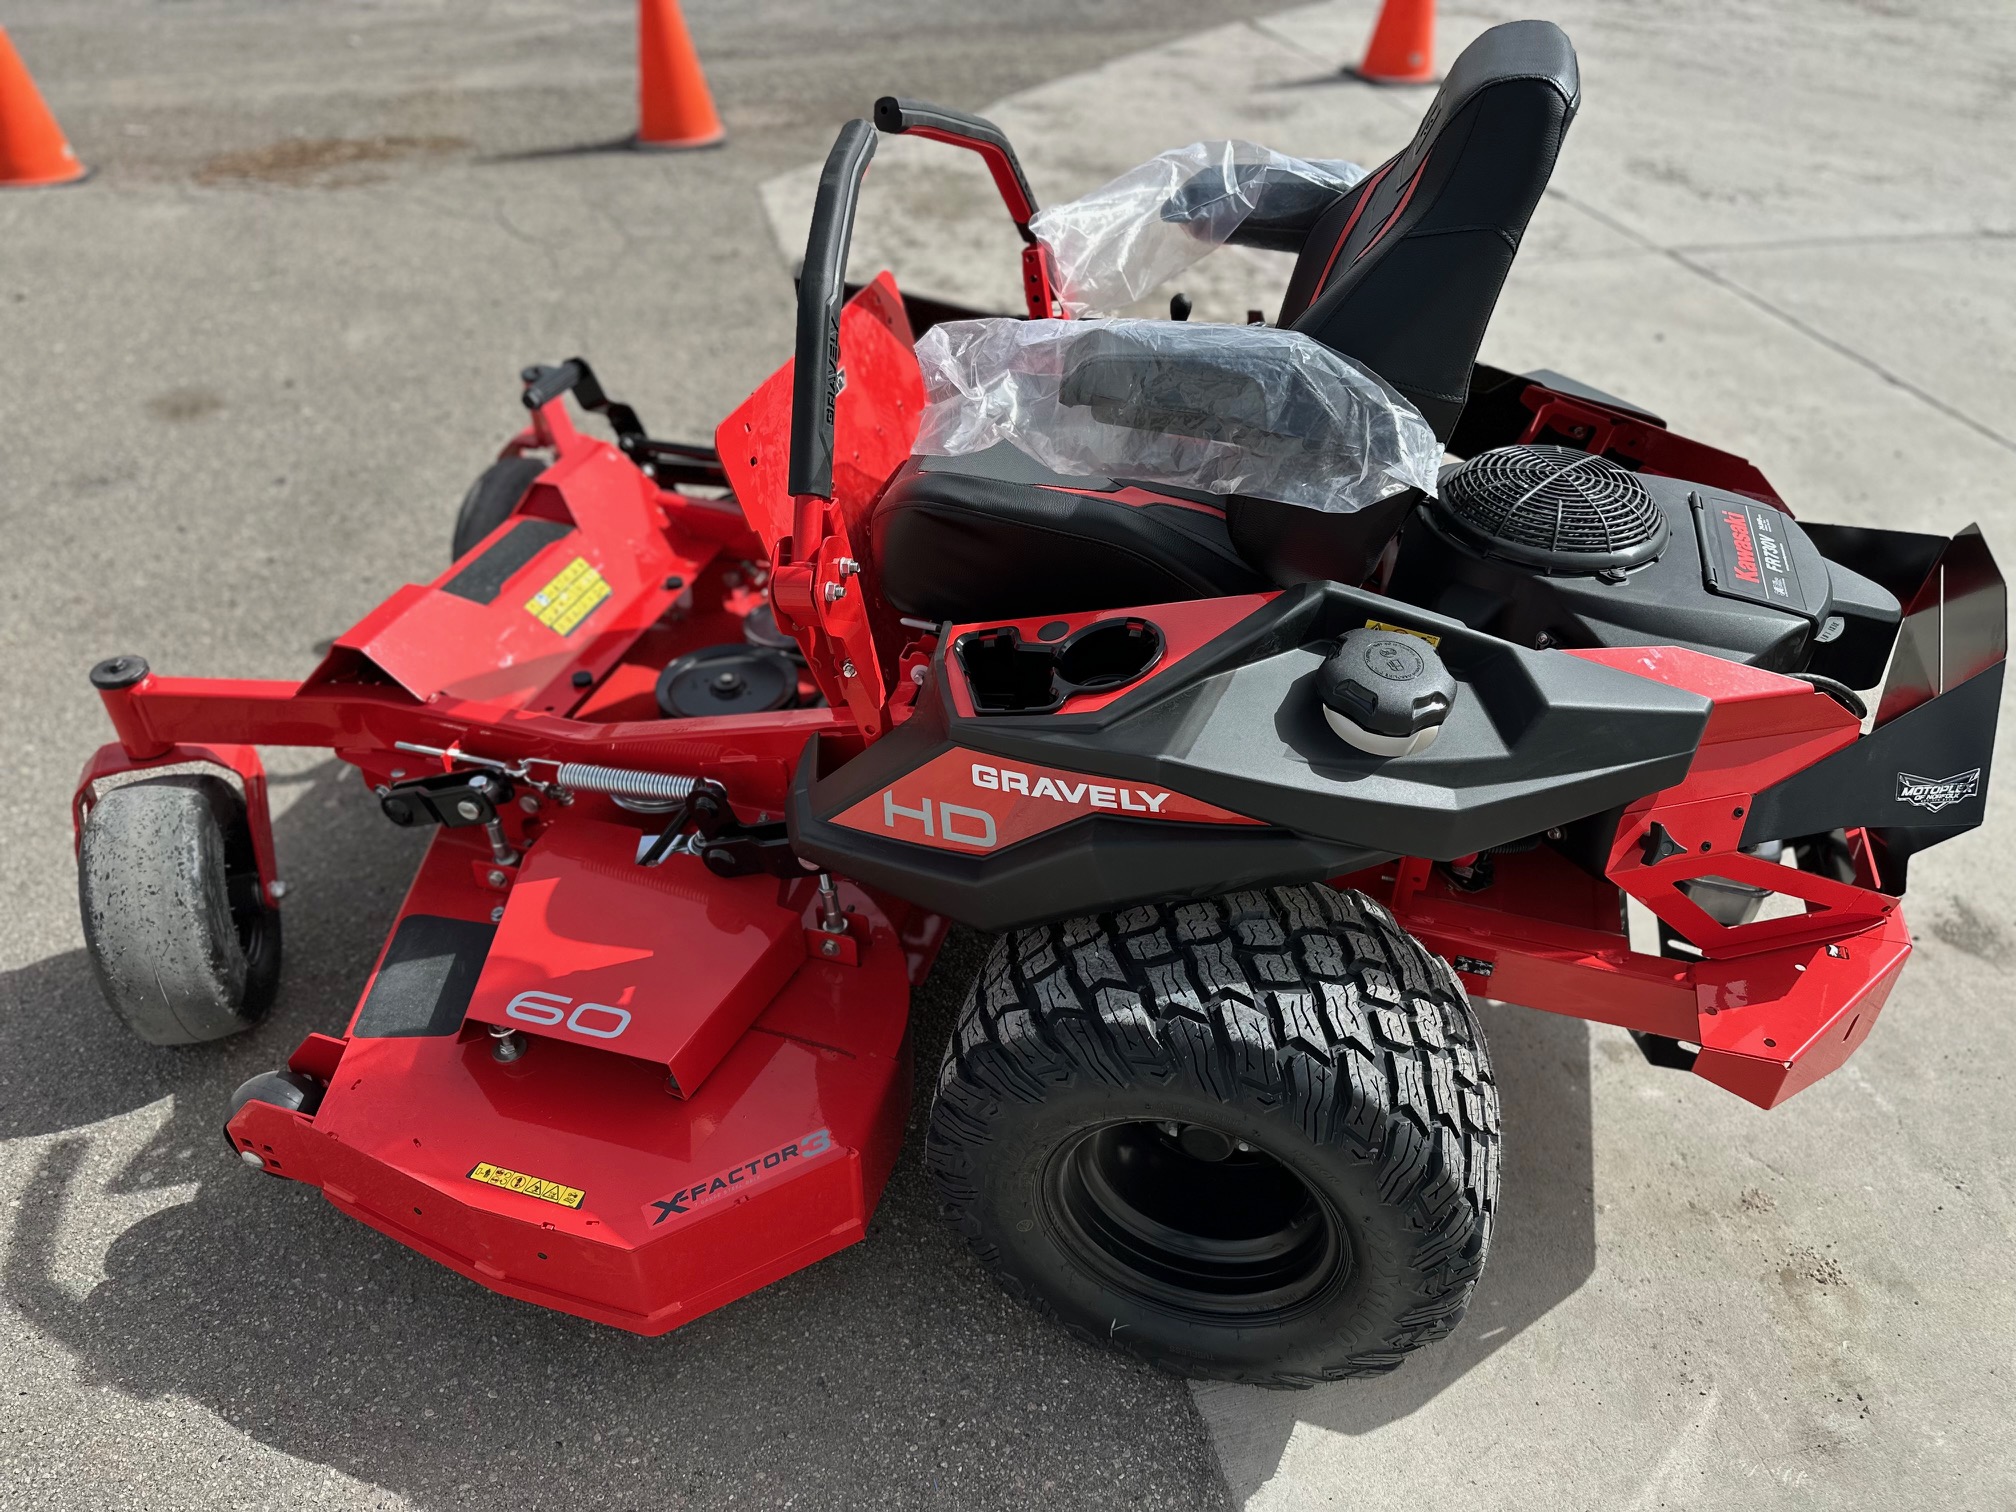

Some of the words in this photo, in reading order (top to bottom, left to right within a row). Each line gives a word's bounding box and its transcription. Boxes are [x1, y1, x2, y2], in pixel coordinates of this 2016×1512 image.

[1722, 510, 1760, 584] Kawasaki
[1759, 534, 1783, 573] FR730V
[972, 763, 1170, 813] GRAVELY
[883, 789, 997, 848] HD
[506, 990, 632, 1039] 60
